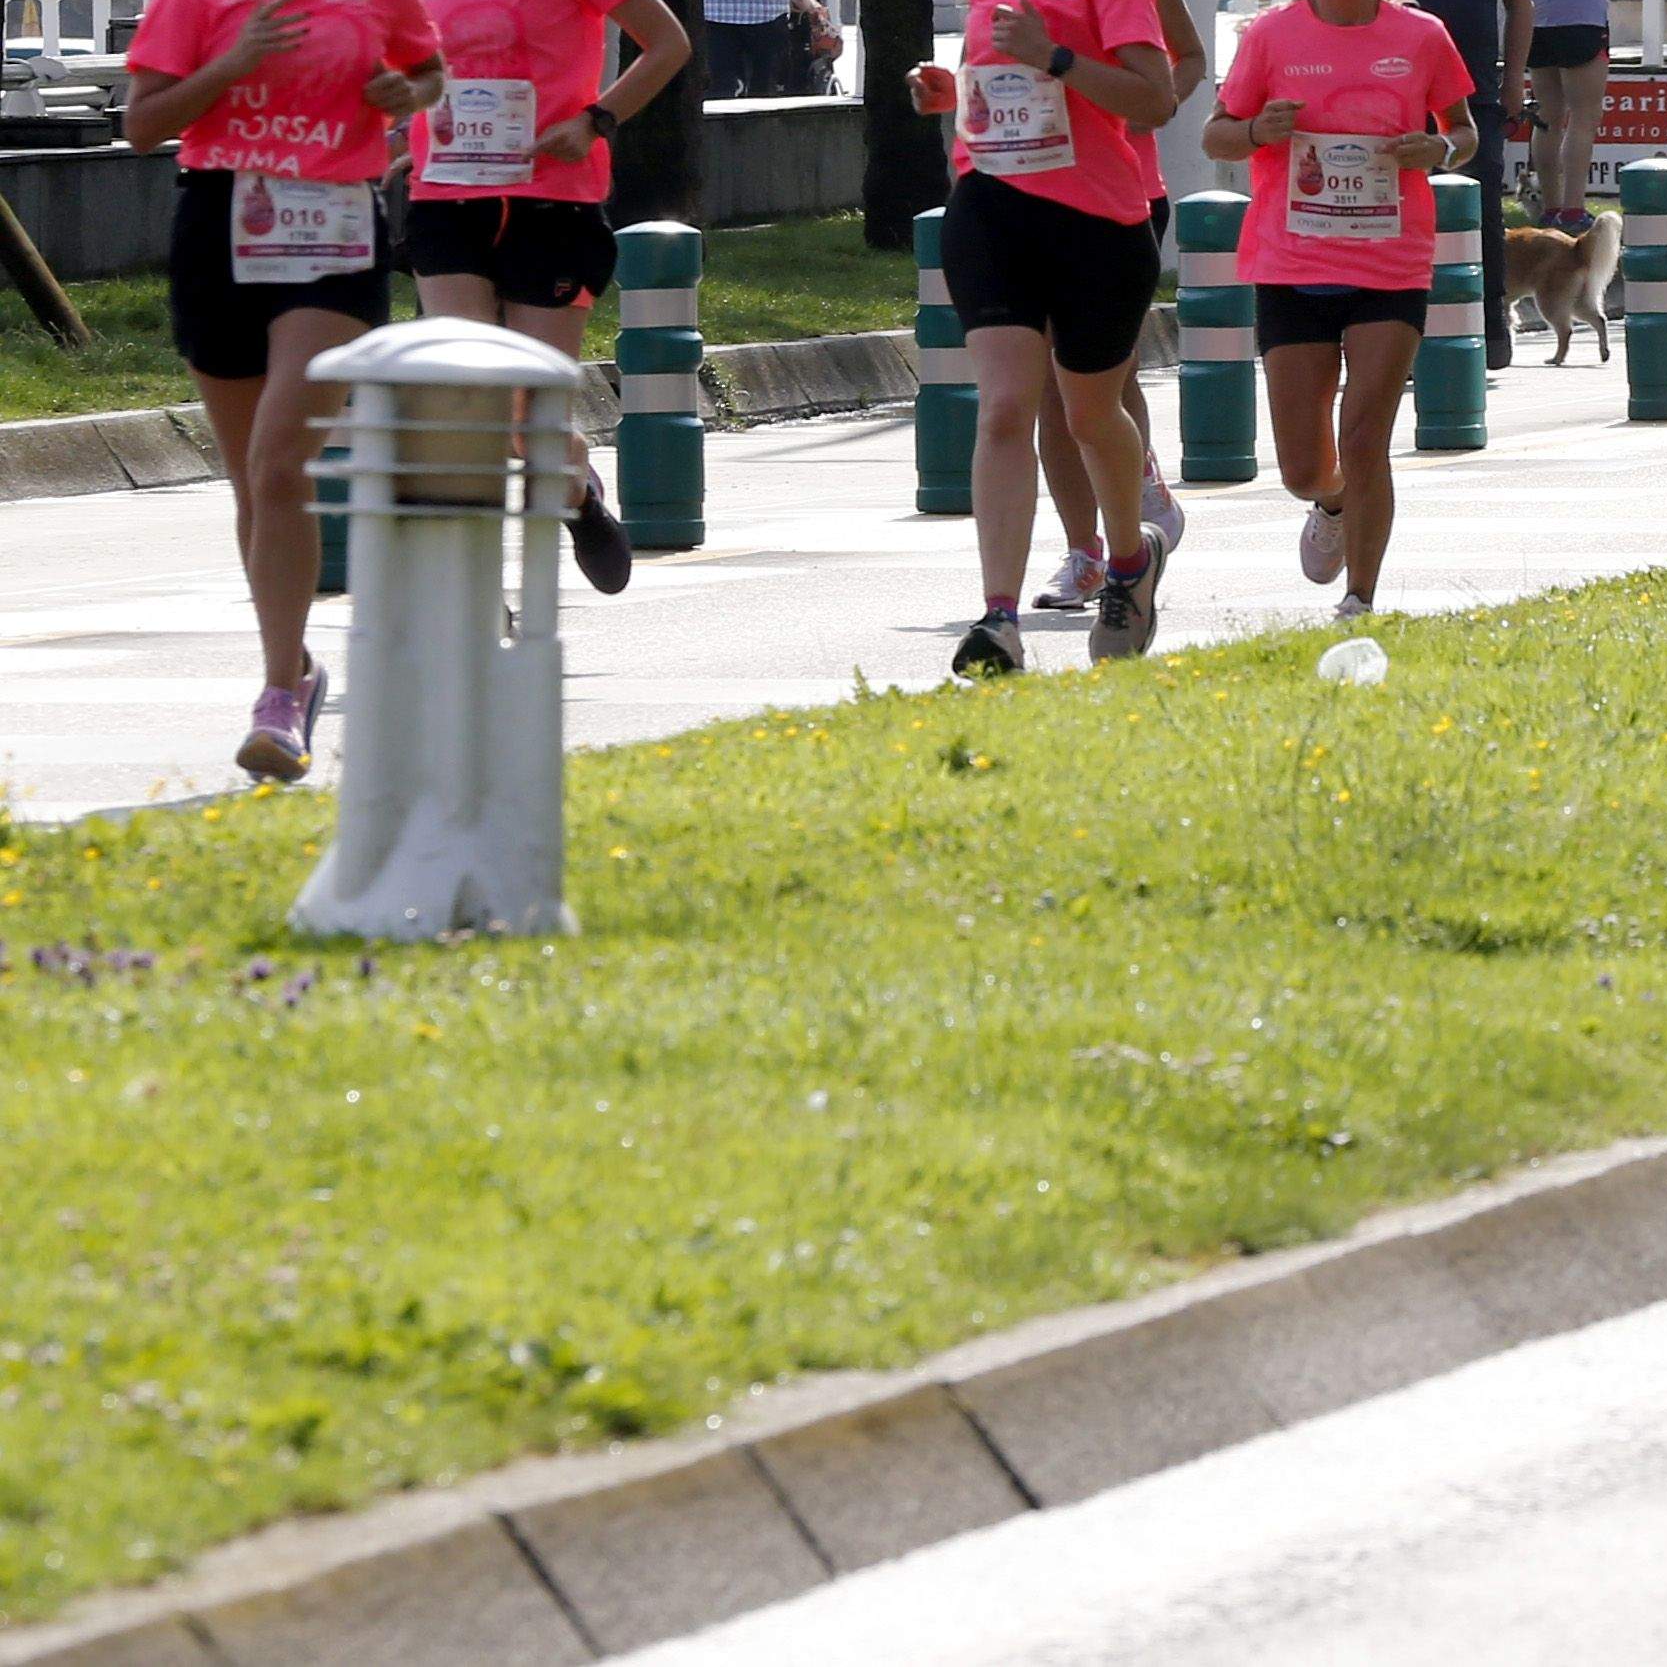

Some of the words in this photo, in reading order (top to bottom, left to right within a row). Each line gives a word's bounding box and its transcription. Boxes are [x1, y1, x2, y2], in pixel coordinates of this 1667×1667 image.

[1284, 64, 1333, 77] OYSHO
[993, 108, 1029, 124] 016
[456, 120, 493, 138] 016
[1327, 176, 1364, 191] 016
[280, 208, 326, 226] 016
